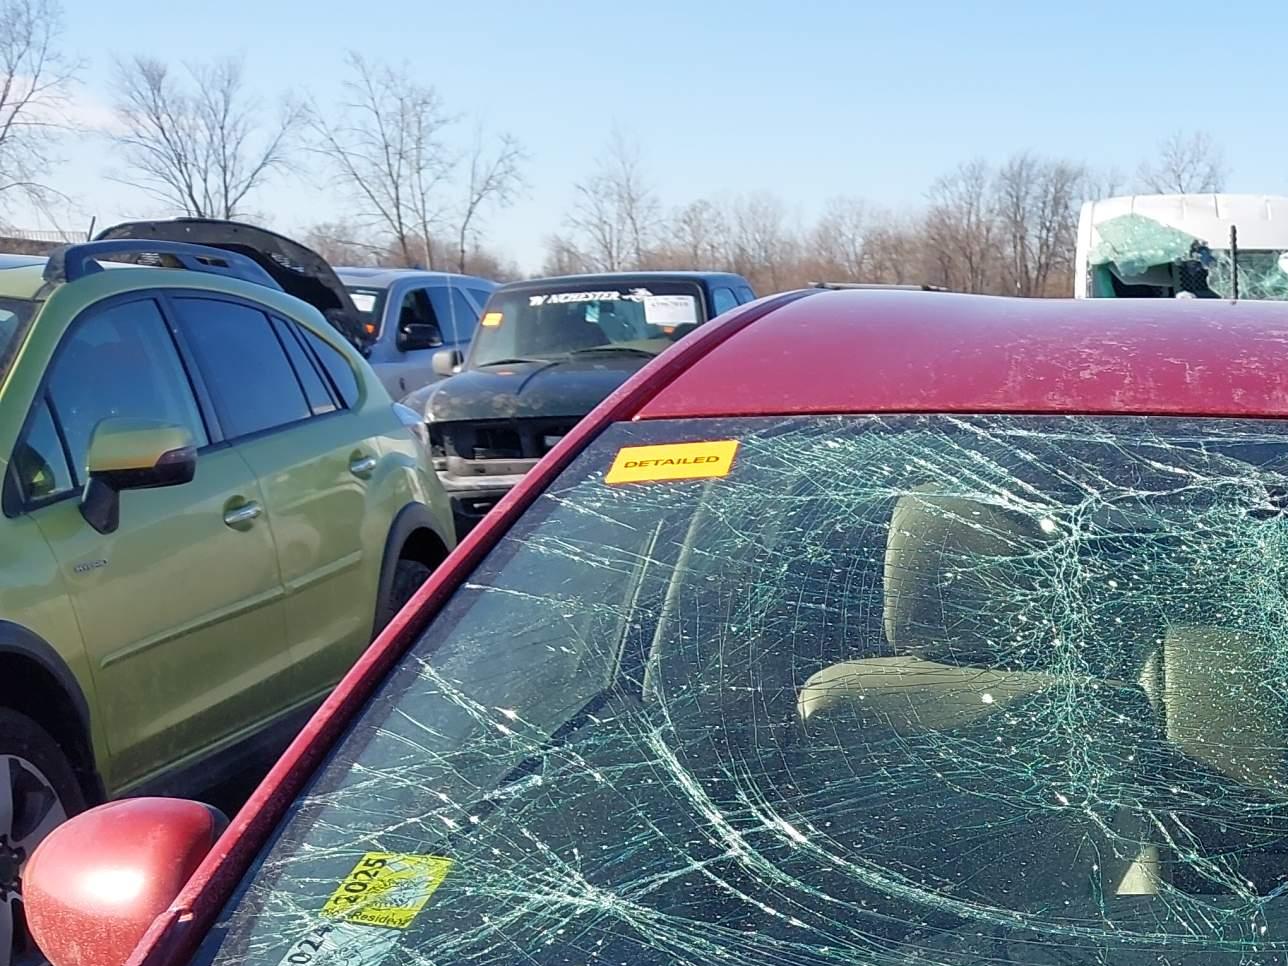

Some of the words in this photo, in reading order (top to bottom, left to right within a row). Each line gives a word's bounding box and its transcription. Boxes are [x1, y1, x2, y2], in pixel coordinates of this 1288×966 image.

[528, 291, 621, 307] WNCHESTER
[623, 455, 721, 469] DETAILED
[333, 858, 388, 905] 2025
